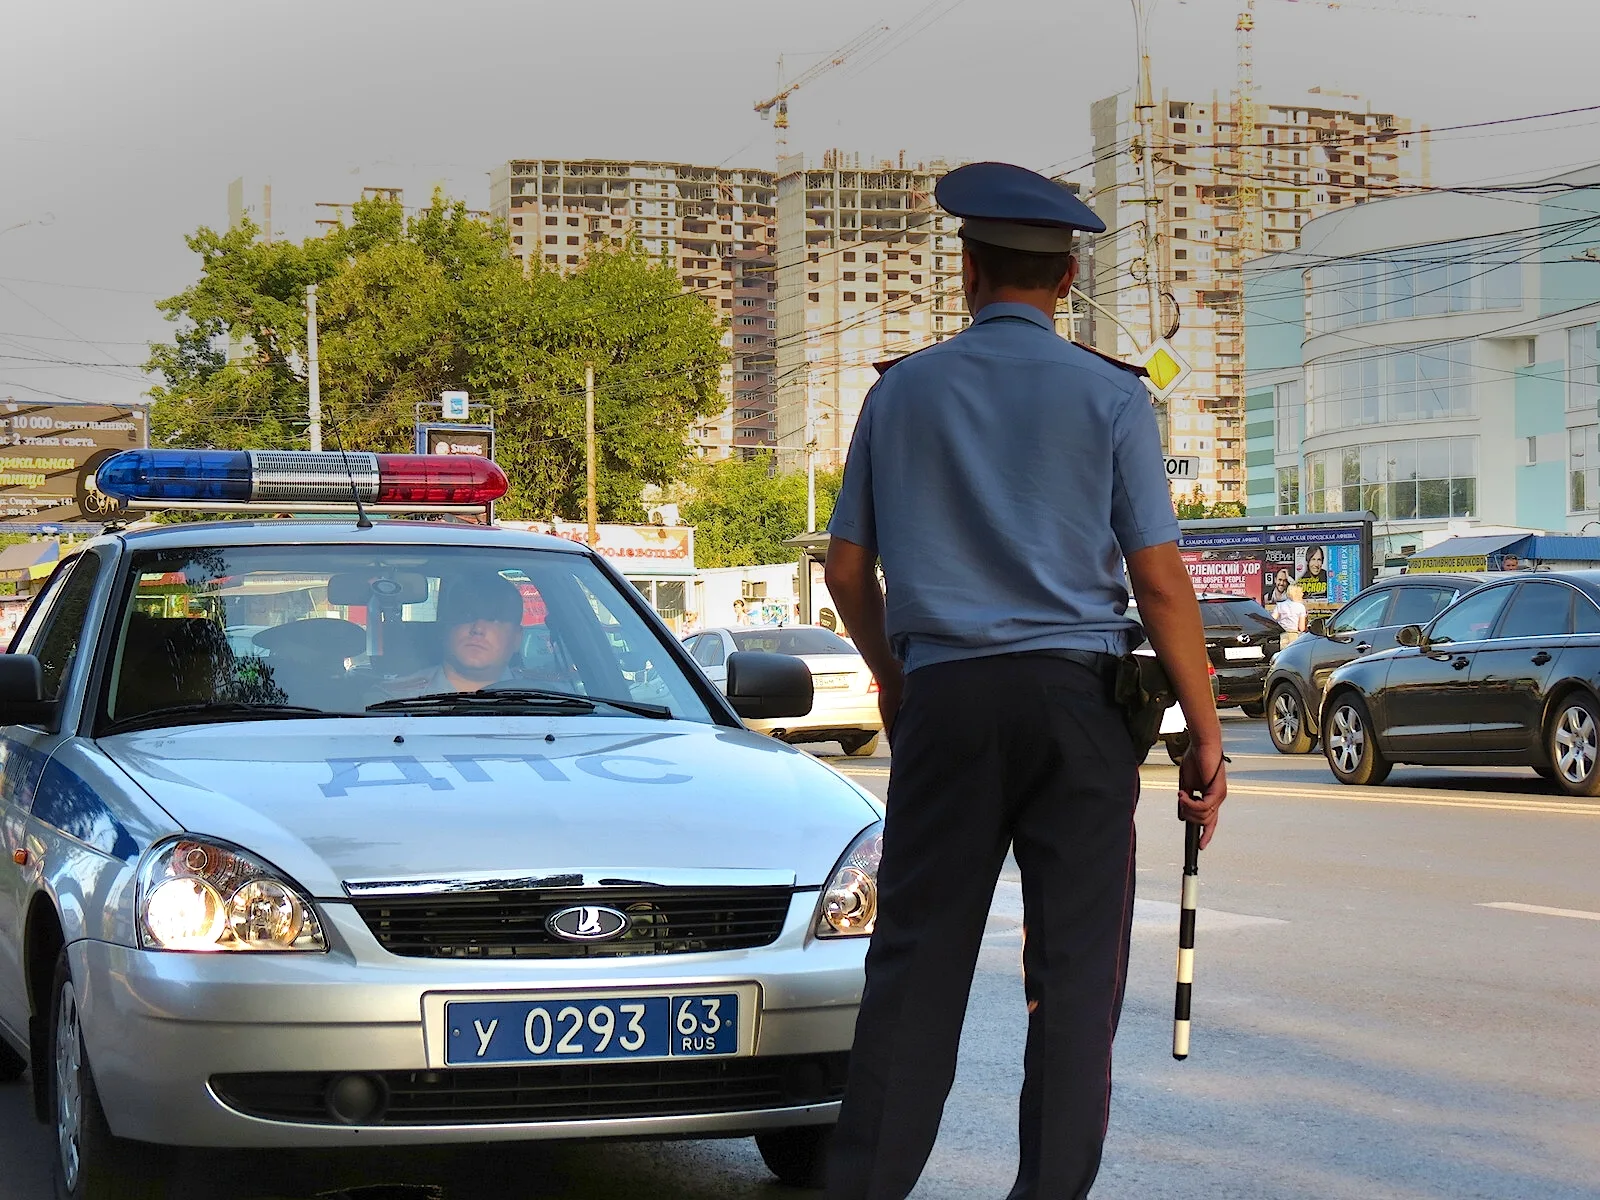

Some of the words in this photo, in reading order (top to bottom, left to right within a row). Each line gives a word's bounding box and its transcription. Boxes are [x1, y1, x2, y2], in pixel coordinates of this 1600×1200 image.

[13, 416, 27, 428] 10
[30, 417, 52, 429] 000
[13, 433, 21, 446] 2
[1164, 459, 1189, 476] ОП
[1265, 553, 1295, 562] АВЕРИН
[1242, 563, 1261, 575] ХОР
[1192, 576, 1202, 584] THE
[1202, 576, 1224, 584] GOSPEL
[1224, 575, 1246, 583] PEOPLE
[1301, 582, 1328, 594] ОСКОВ
[317, 753, 693, 798] ДПС
[676, 999, 721, 1035] 63
[524, 1004, 646, 1054] 0293
[682, 1037, 716, 1051] RUS
